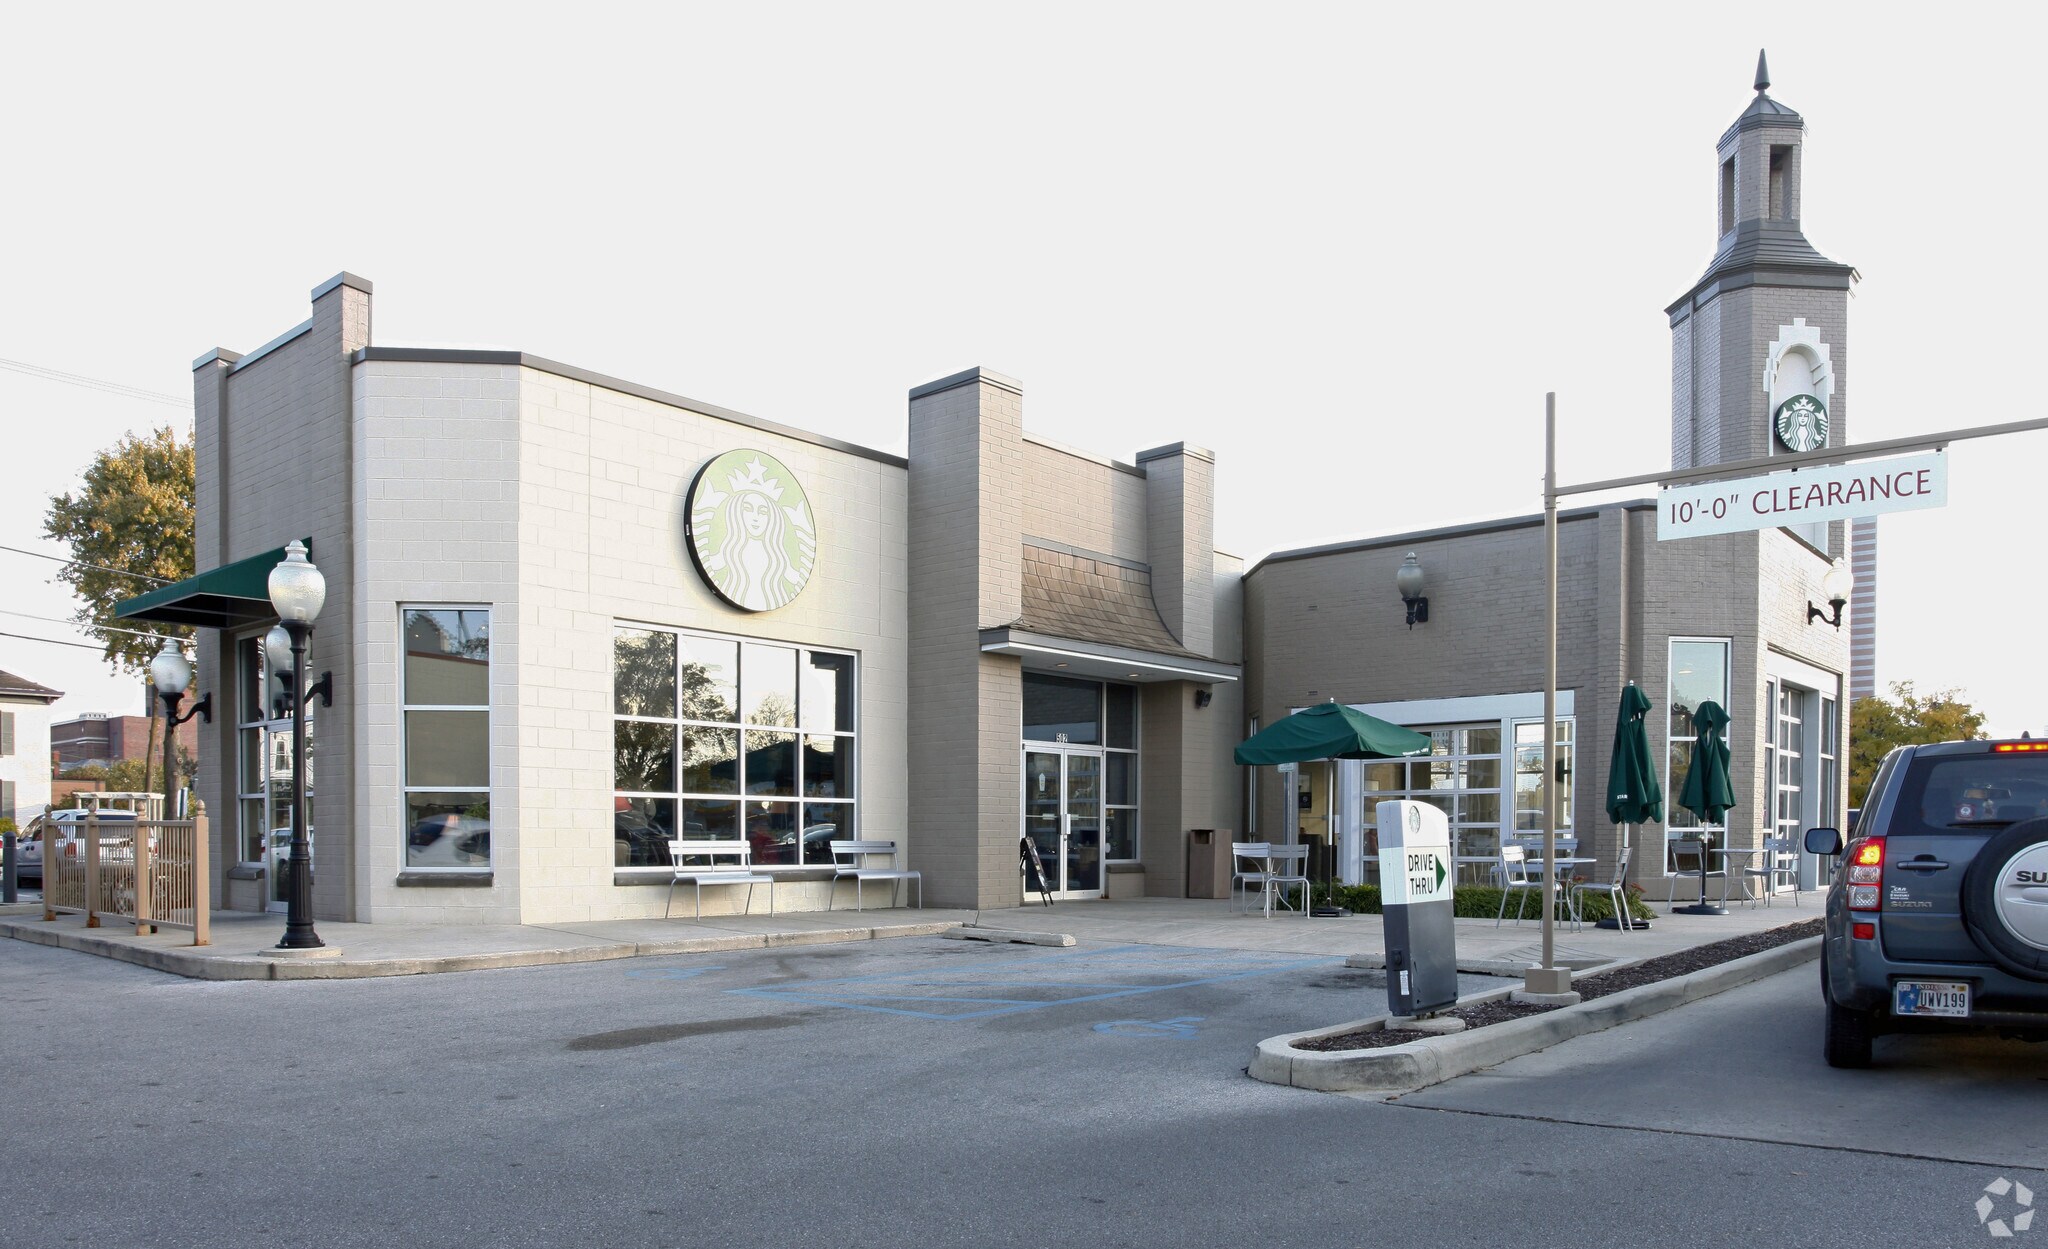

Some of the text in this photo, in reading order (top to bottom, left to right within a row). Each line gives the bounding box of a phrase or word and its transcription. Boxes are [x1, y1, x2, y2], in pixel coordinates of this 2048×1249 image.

[1752, 469, 1932, 515] CLEARANCE
[1408, 853, 1434, 872] DRIVE
[2016, 870, 2048, 883] SU
[1410, 877, 1433, 895] THRU
[1890, 900, 1933, 908] SUZUKI
[1920, 992, 1966, 1008] UWV199
